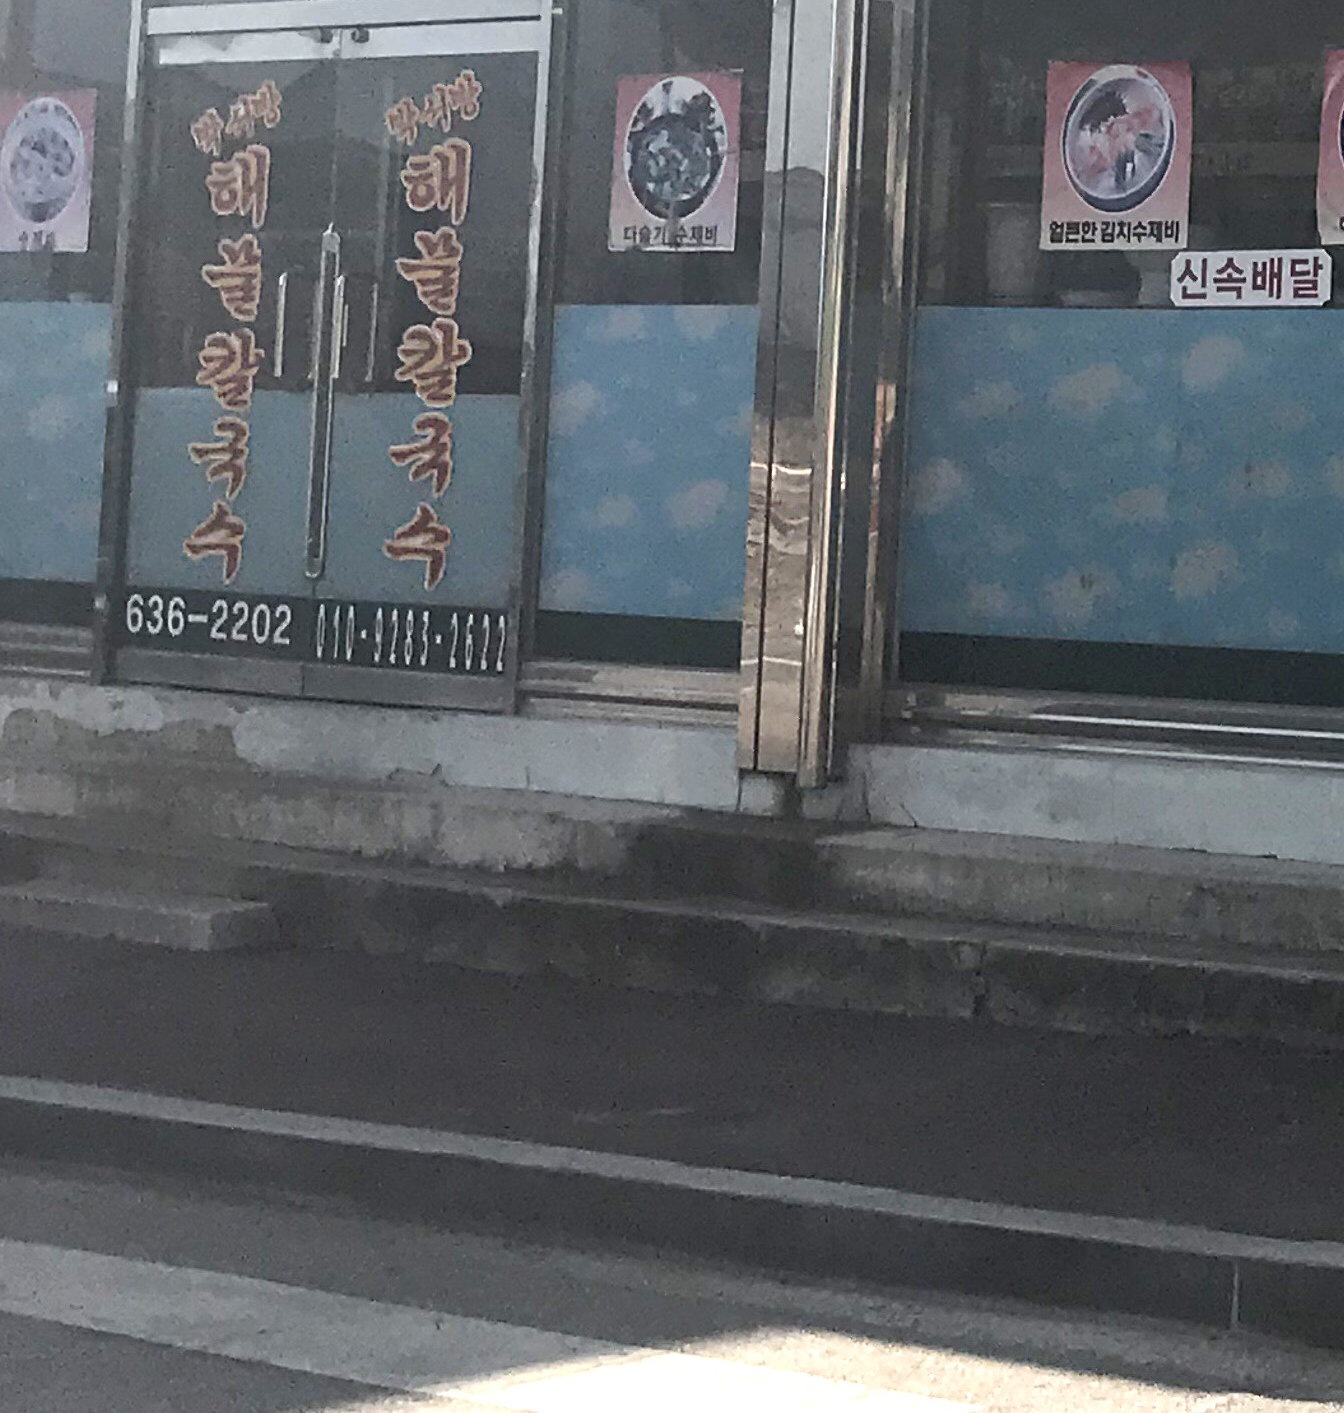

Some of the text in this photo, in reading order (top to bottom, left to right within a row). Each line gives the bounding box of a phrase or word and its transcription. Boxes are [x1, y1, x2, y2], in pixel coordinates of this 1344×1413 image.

[384, 69, 483, 146] 박서방
[1100, 220, 1180, 244] 김치수제비
[1176, 256, 1324, 300] 신속배달
[183, 144, 272, 585] 해물칼국수
[382, 138, 473, 590] 해물칼국수
[126, 593, 293, 646] 636-2202
[315, 603, 507, 673] 010-9283-2622
